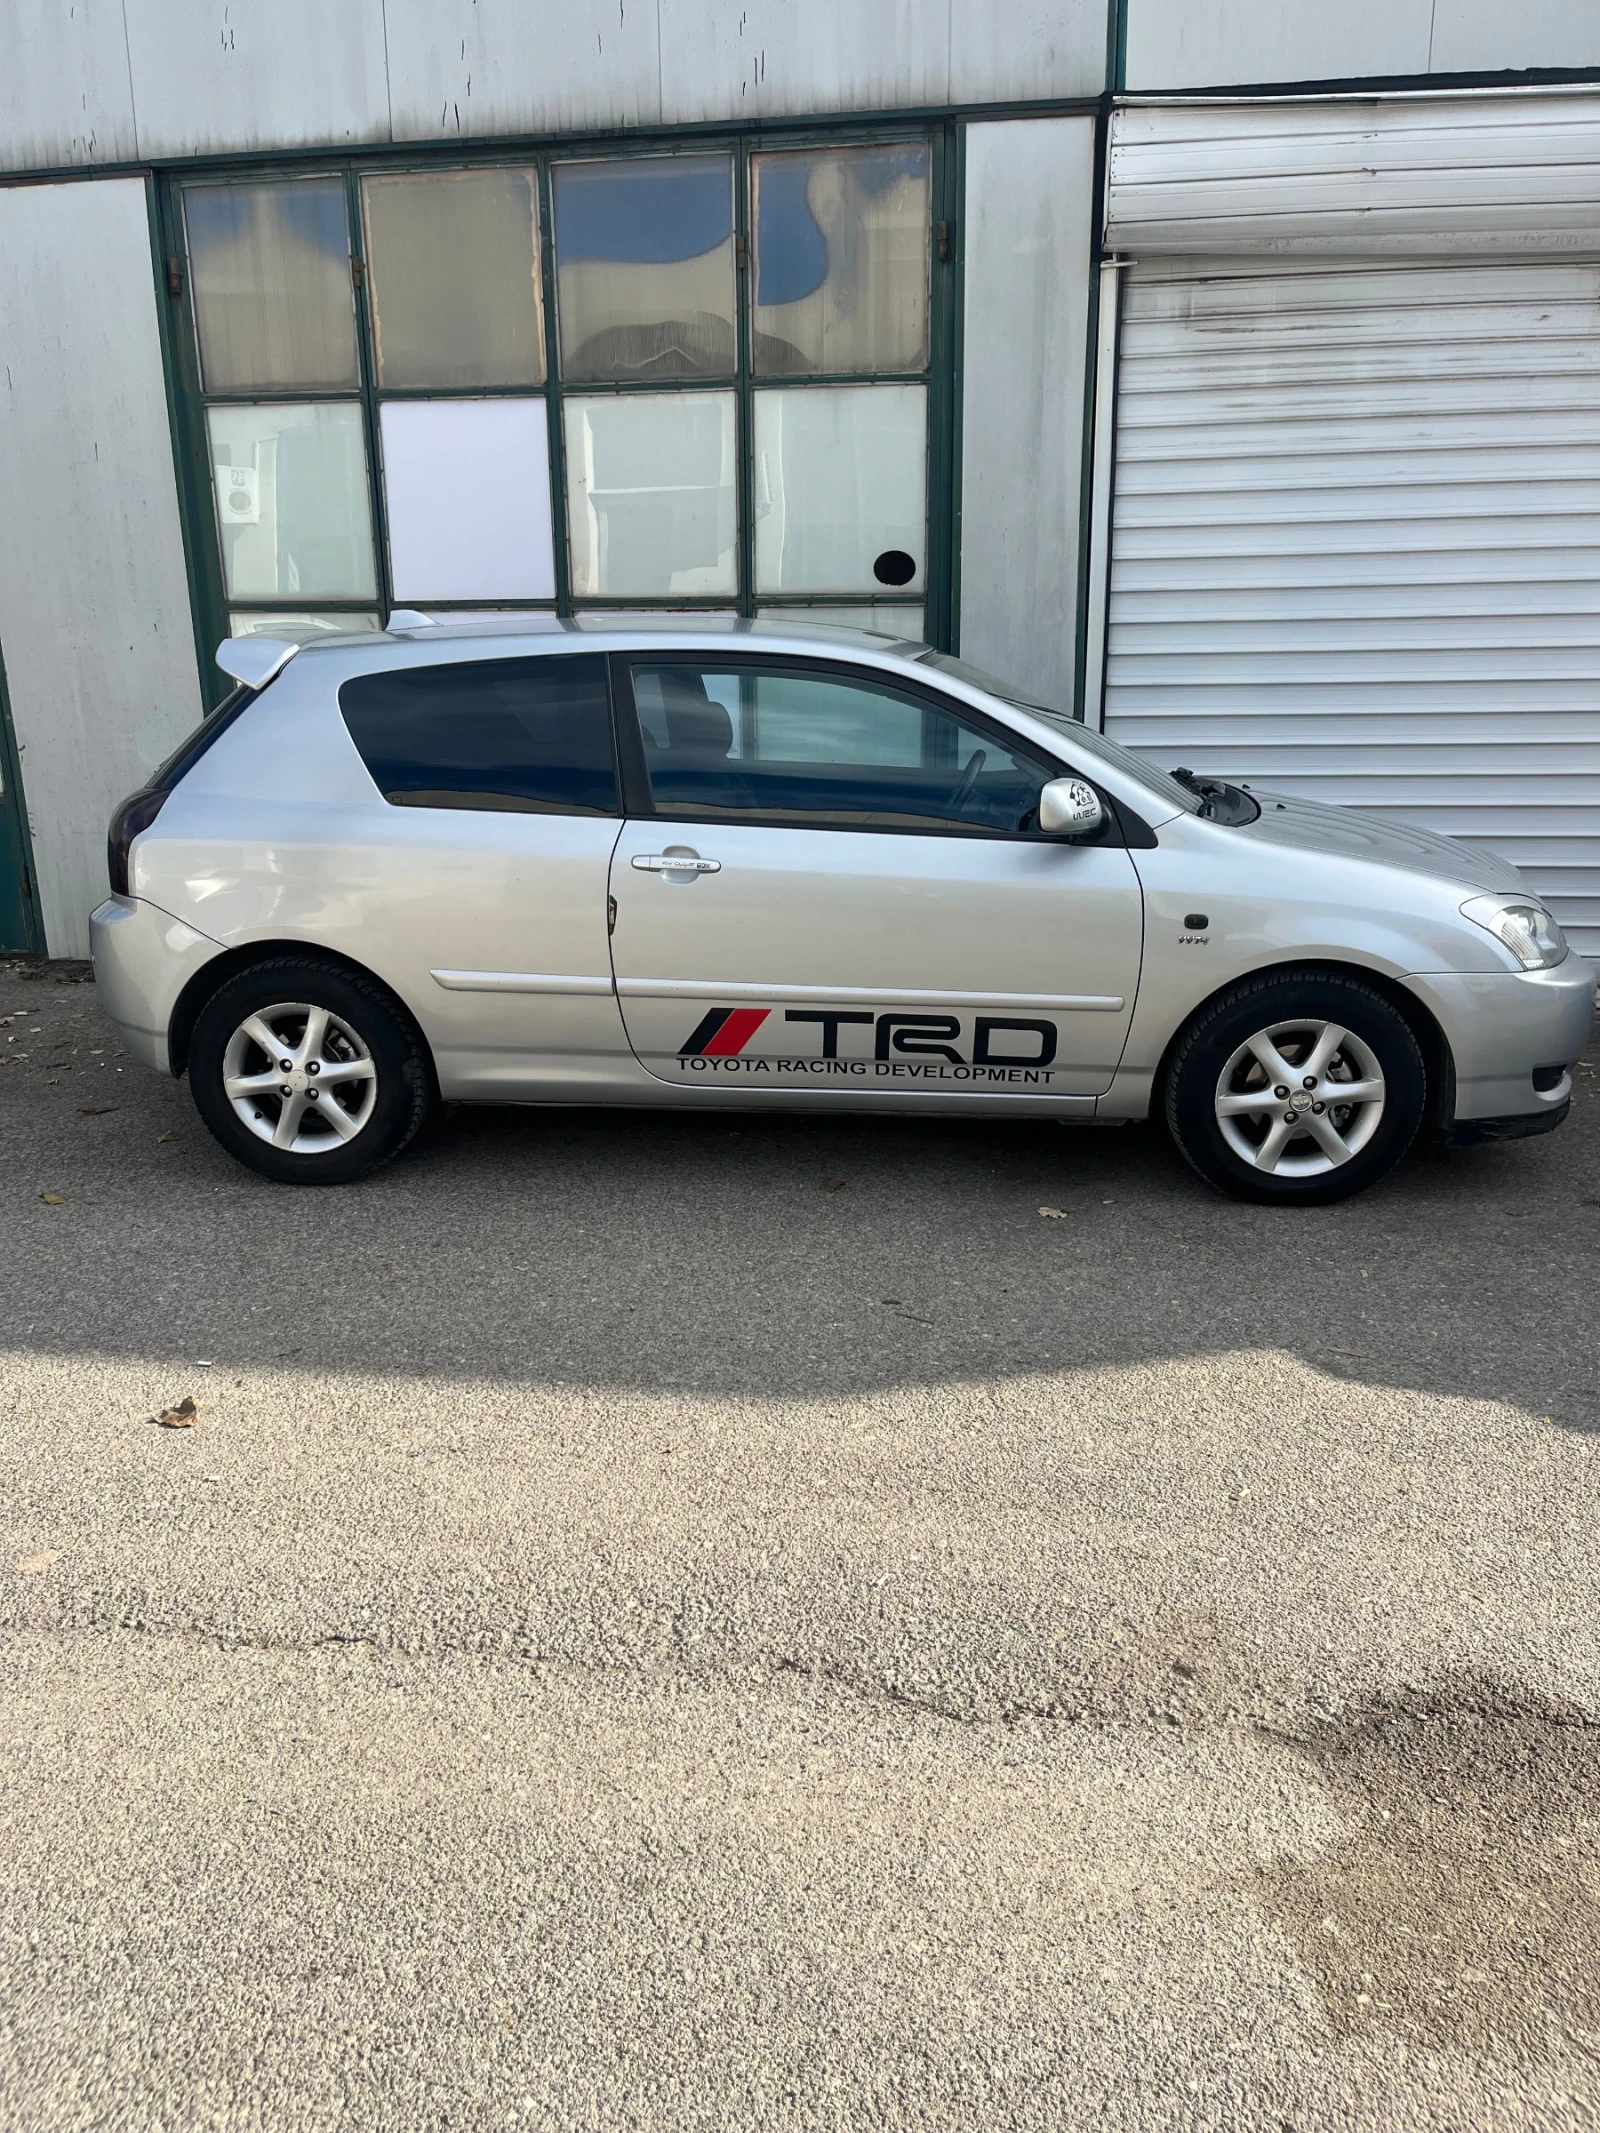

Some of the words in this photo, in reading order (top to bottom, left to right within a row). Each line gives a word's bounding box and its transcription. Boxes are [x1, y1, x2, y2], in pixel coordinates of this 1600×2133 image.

[1073, 807, 1097, 821] WRC
[785, 1009, 1058, 1068] TRD
[676, 1057, 770, 1072] TOYOTA
[777, 1059, 866, 1075] RACING
[875, 1063, 1056, 1084] DEVELOPMENT
